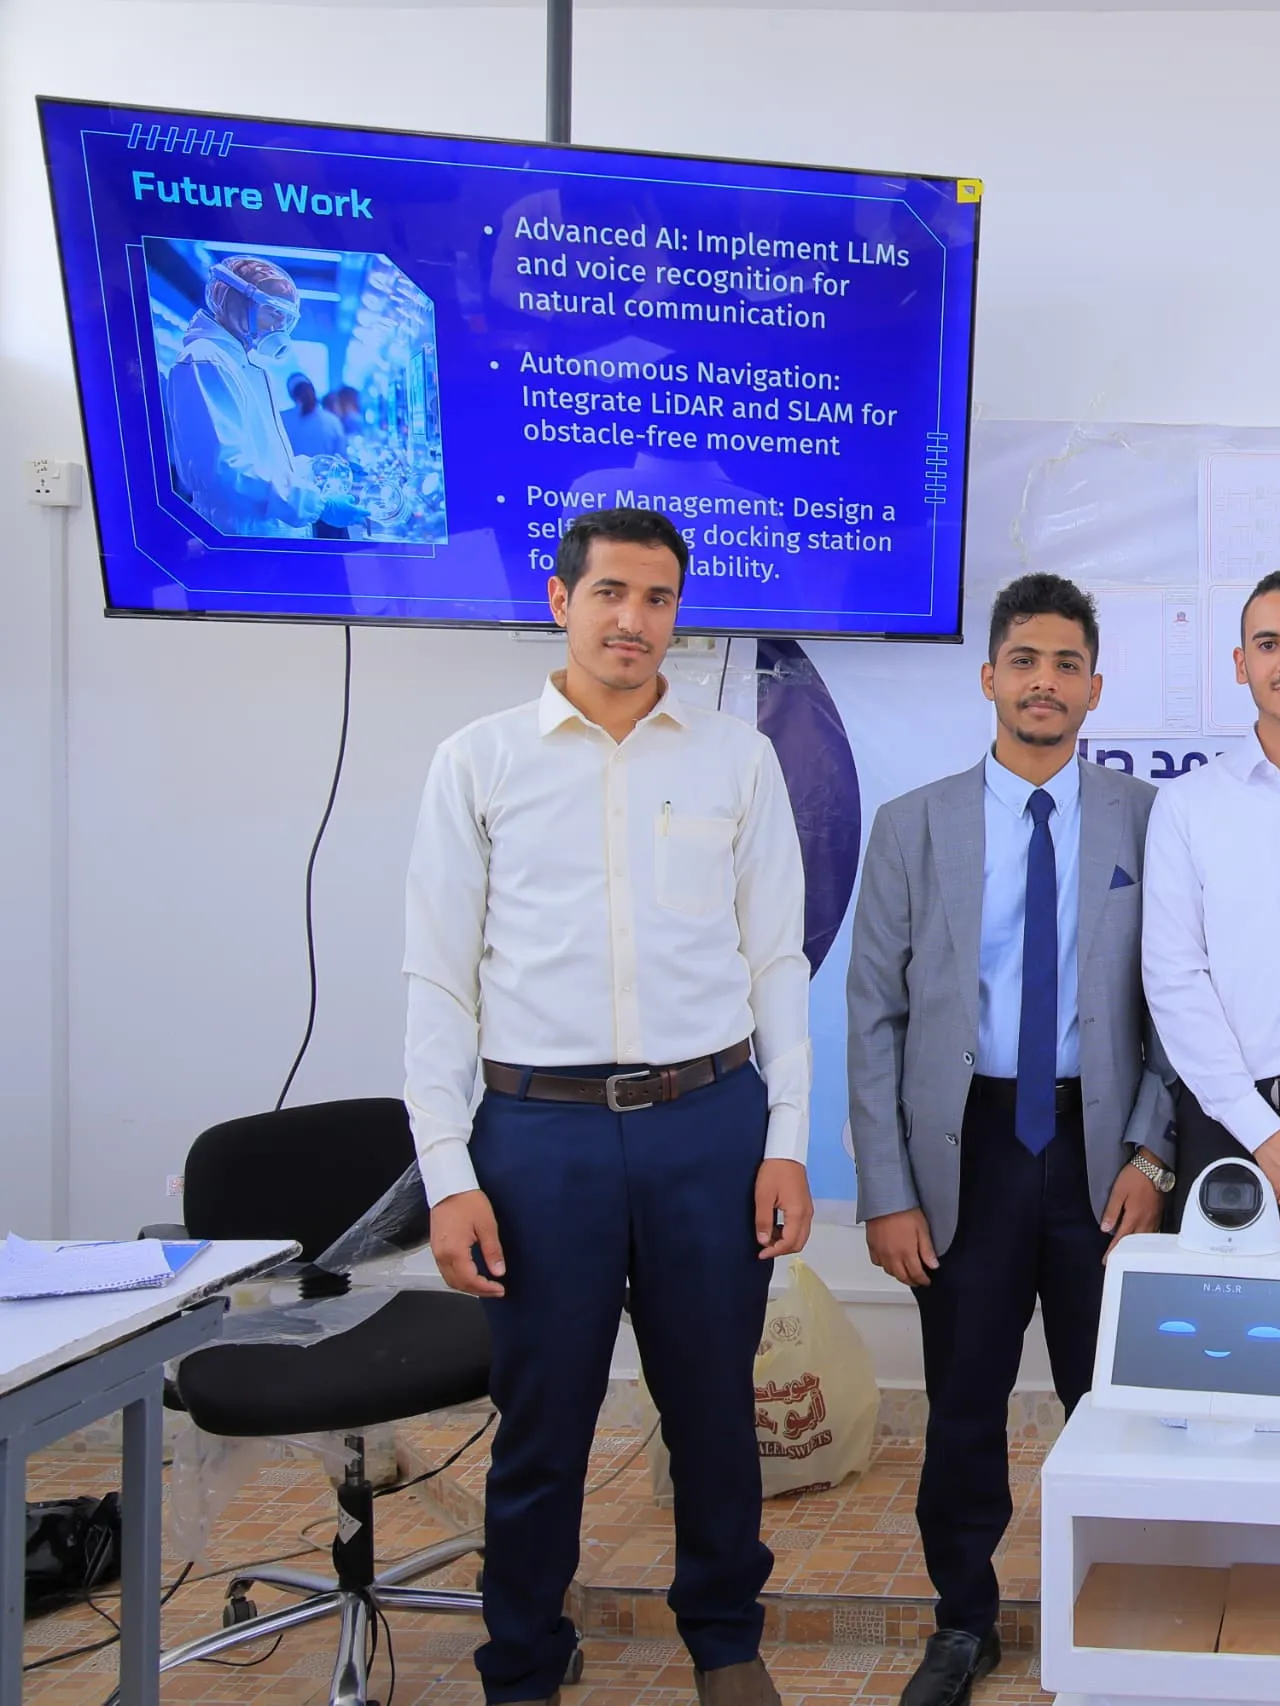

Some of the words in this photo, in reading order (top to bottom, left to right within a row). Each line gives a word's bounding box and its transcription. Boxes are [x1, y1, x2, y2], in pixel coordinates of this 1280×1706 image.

[133, 171, 262, 209] Future
[274, 183, 373, 219] Work
[515, 216, 646, 247] Advanced
[656, 227, 687, 250] AI:
[698, 230, 839, 261] Implement
[849, 241, 909, 266] LLMs
[517, 253, 566, 277] and
[576, 256, 646, 282] voice
[657, 266, 803, 293] recognition
[812, 272, 850, 296] for
[520, 291, 615, 315] natural
[625, 299, 825, 328] communication
[520, 352, 688, 381] Autonomous
[698, 362, 839, 391] Navigation:
[522, 386, 641, 415] Integrate
[652, 391, 723, 416] LiDAR
[733, 398, 778, 420] and
[788, 401, 853, 423] SLAM
[862, 403, 897, 426] for
[524, 419, 697, 448] obstacle-free
[708, 433, 840, 455] movement
[527, 486, 606, 508] Power
[616, 489, 784, 518] Management:
[794, 497, 872, 524] Design
[882, 505, 896, 521] a
[704, 524, 800, 553] docking
[808, 530, 891, 551] station
[528, 549, 554, 570] fo
[690, 554, 779, 581] lability.
